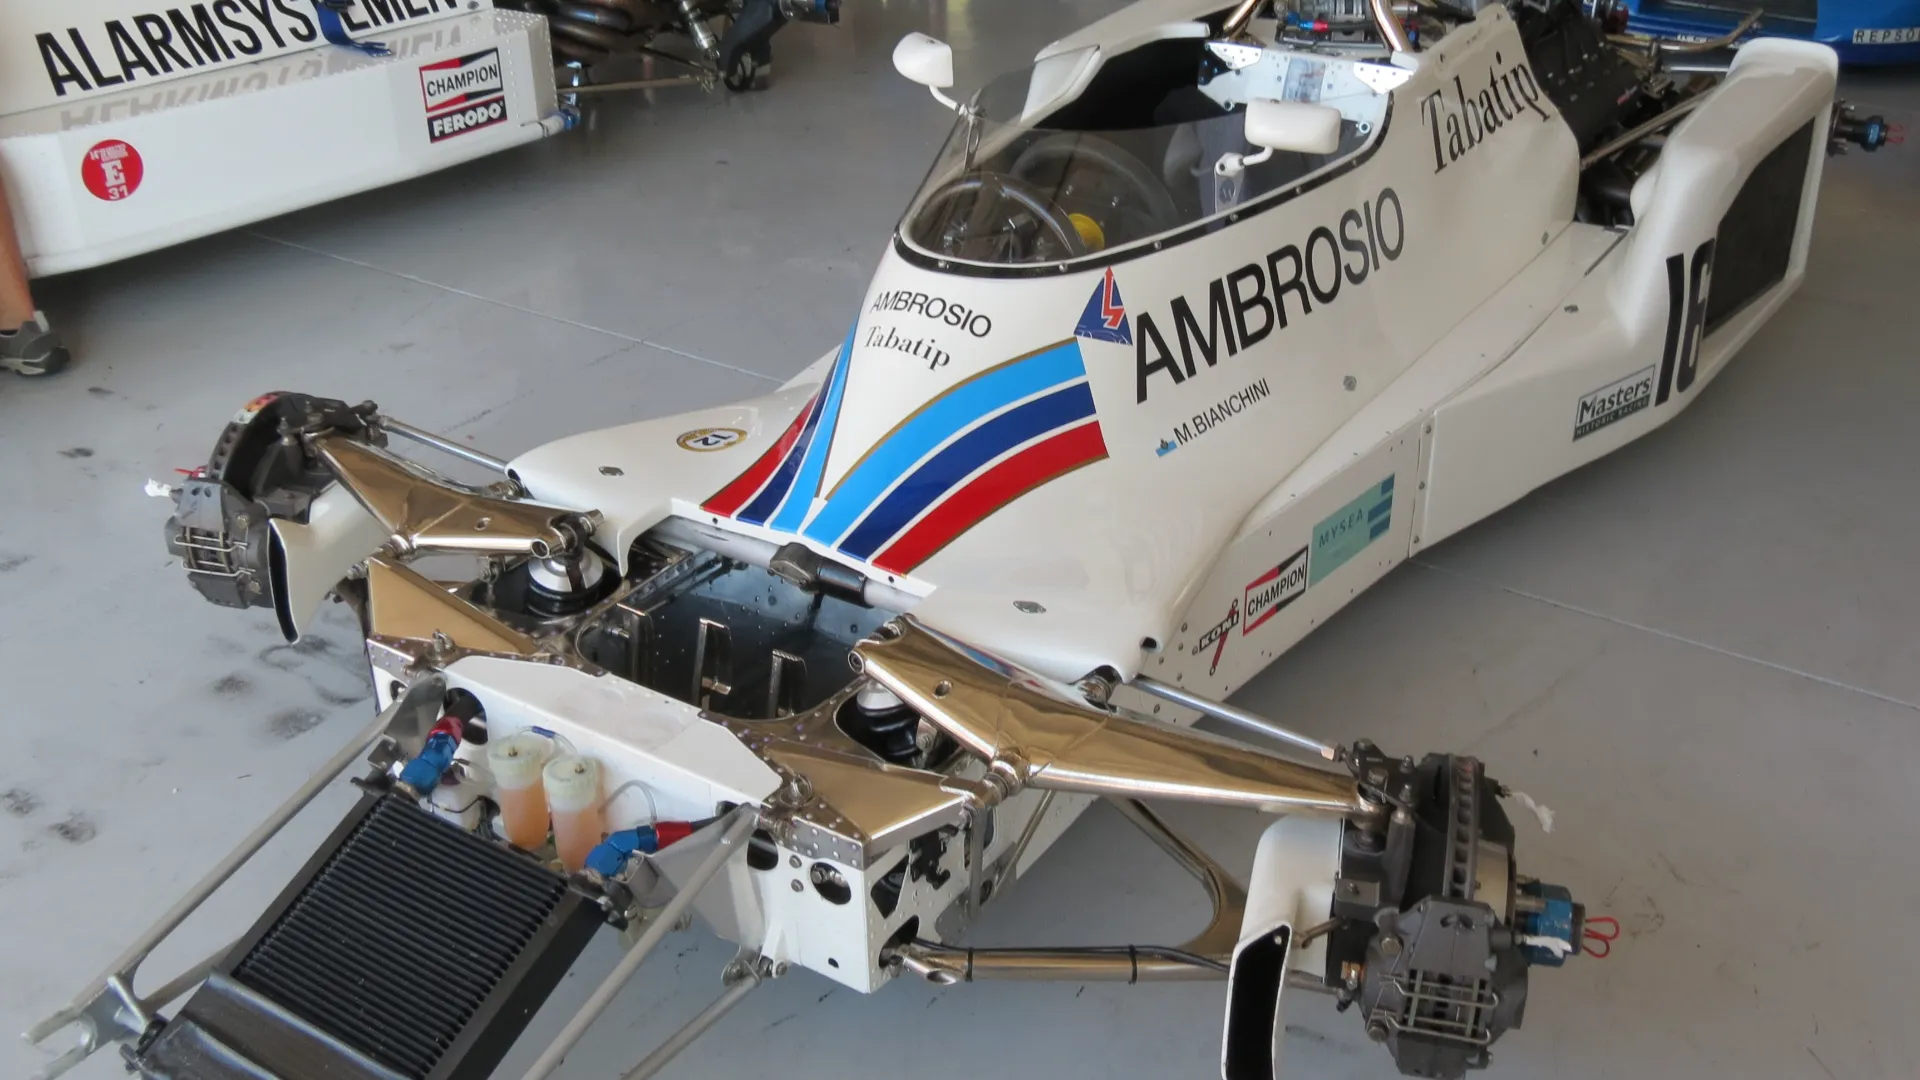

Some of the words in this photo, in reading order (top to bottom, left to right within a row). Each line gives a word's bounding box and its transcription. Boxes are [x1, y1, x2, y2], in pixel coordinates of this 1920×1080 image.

[35, 0, 457, 96] ALARMSYSE
[1855, 28, 1920, 43] REPSO
[427, 64, 498, 97] CHAMPION
[433, 102, 501, 137] FERODO
[1421, 50, 1550, 175] Tabatip
[870, 290, 992, 339] AMBROSIO
[1137, 187, 1404, 405] AMBROSIO
[863, 325, 951, 371] Tabatip
[1173, 377, 1271, 446] M.BIANCHINI
[1579, 377, 1651, 424] Masters
[1319, 507, 1363, 549] MYSEA
[1247, 565, 1305, 616] CHAMPION
[1201, 612, 1238, 650] KONI
